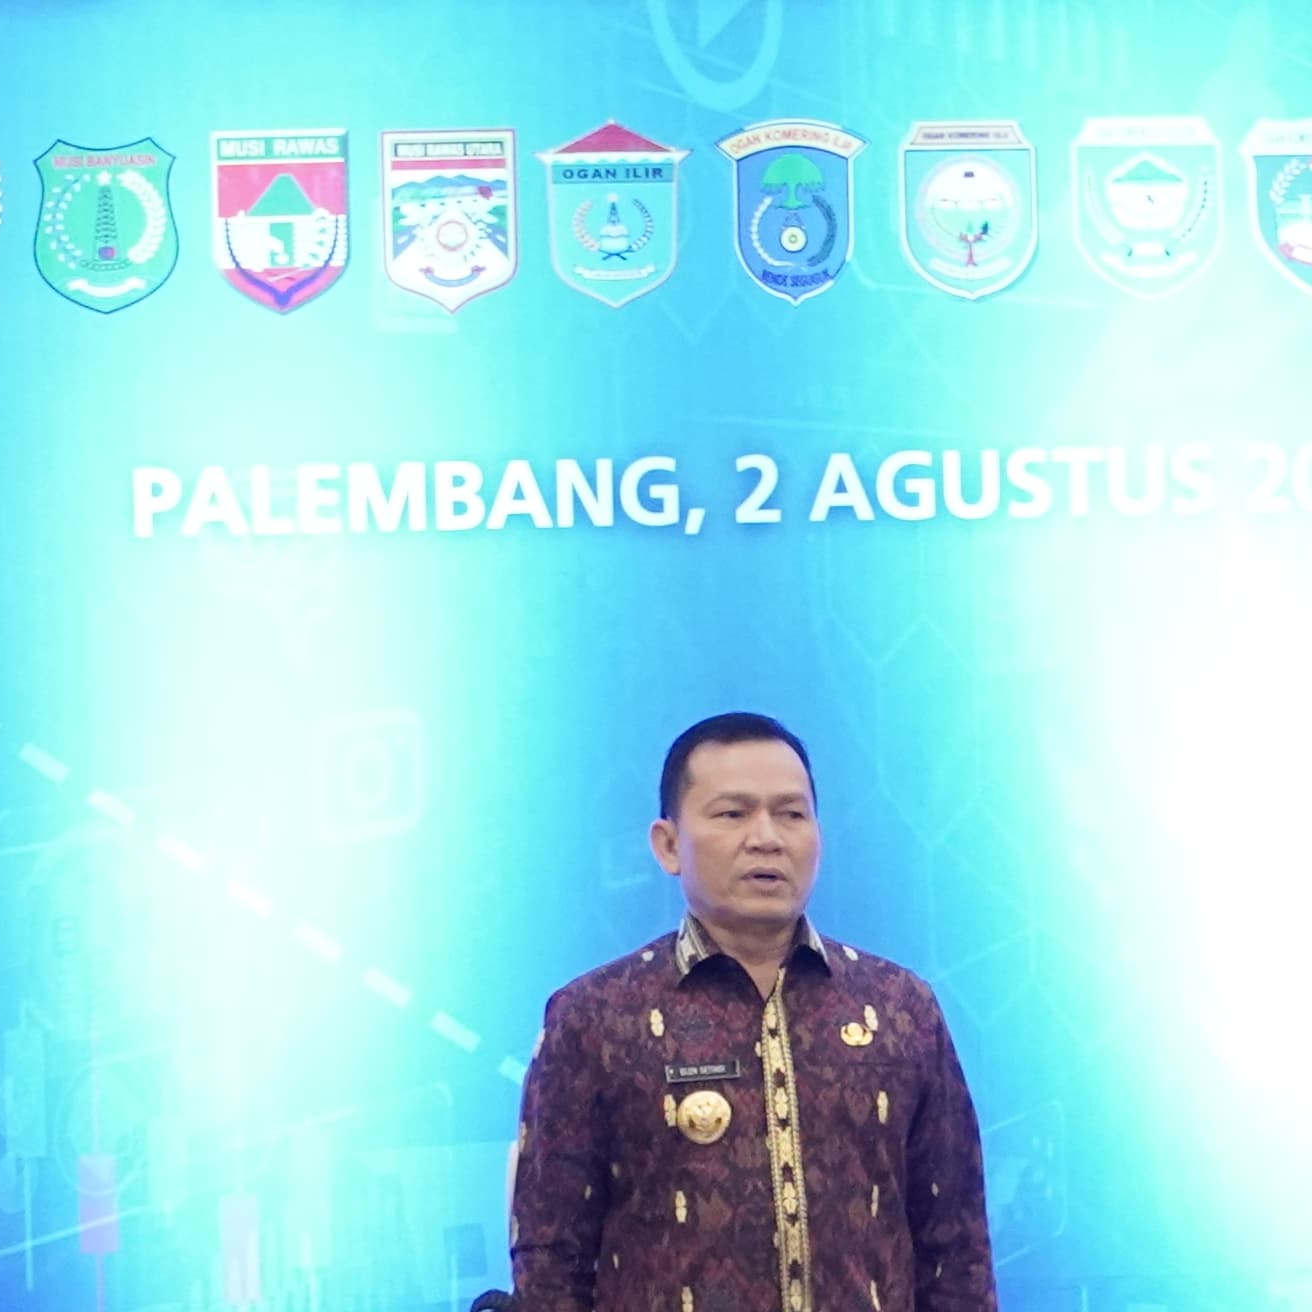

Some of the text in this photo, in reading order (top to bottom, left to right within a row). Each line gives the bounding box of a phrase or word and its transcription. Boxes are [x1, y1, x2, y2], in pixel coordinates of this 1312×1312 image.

[219, 137, 339, 158] MUSI RAWAS
[562, 167, 664, 179] OGAN ILIR
[130, 455, 706, 538] PALEMBANG,
[733, 455, 784, 525] 2
[809, 444, 1217, 523] AGUSTUS
